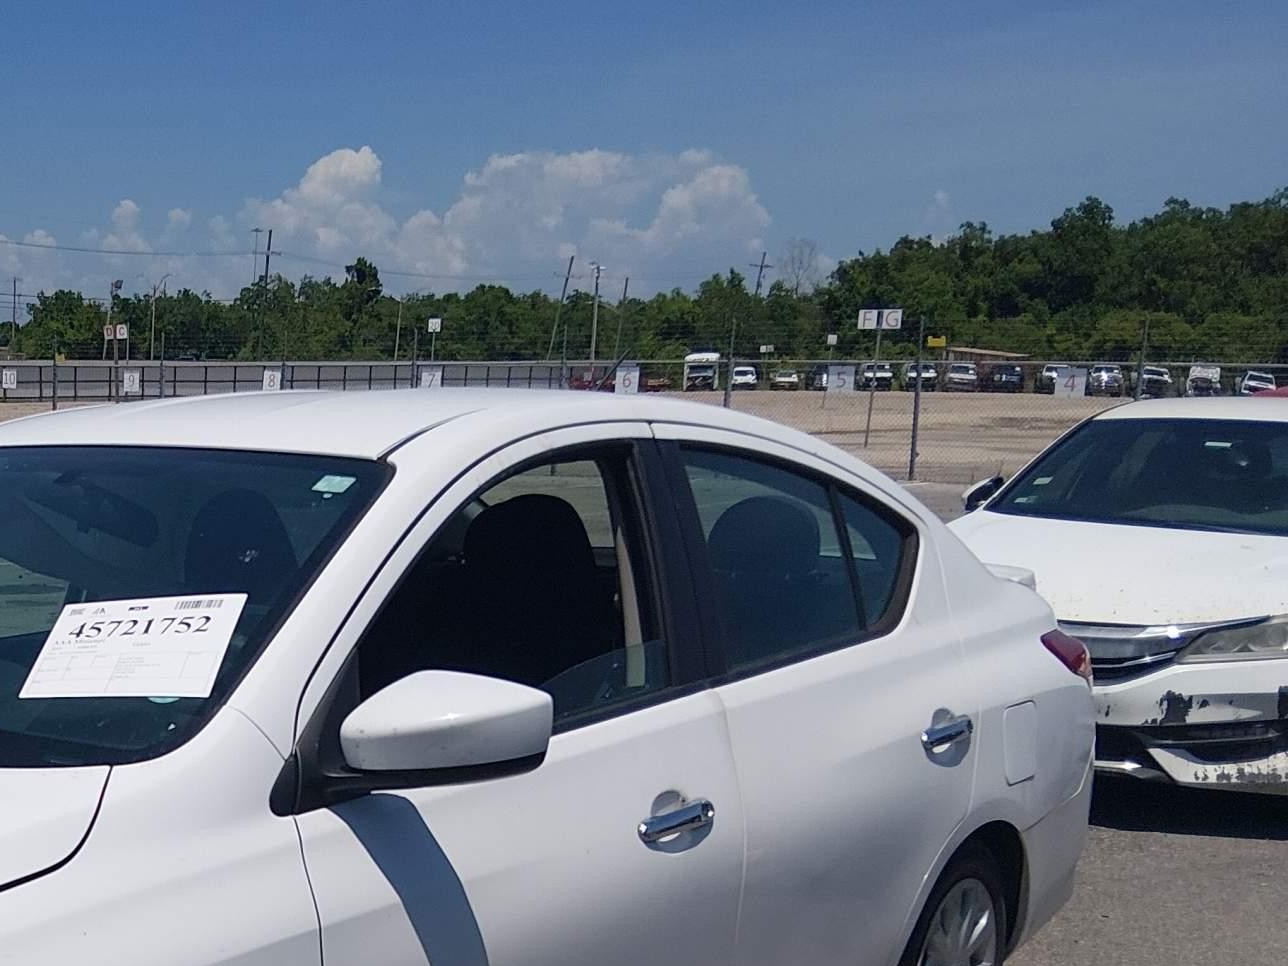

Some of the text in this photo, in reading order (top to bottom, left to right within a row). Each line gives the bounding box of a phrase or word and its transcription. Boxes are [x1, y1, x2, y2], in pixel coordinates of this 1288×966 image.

[863, 311, 873, 328] F
[885, 310, 899, 328] G
[4, 372, 16, 385] 10
[128, 374, 135, 387] 9
[267, 373, 276, 388] 8
[428, 372, 436, 389] 7
[622, 371, 632, 388] 6
[837, 371, 847, 388] 5
[1063, 374, 1077, 392] 4
[68, 615, 212, 638] 45721752
